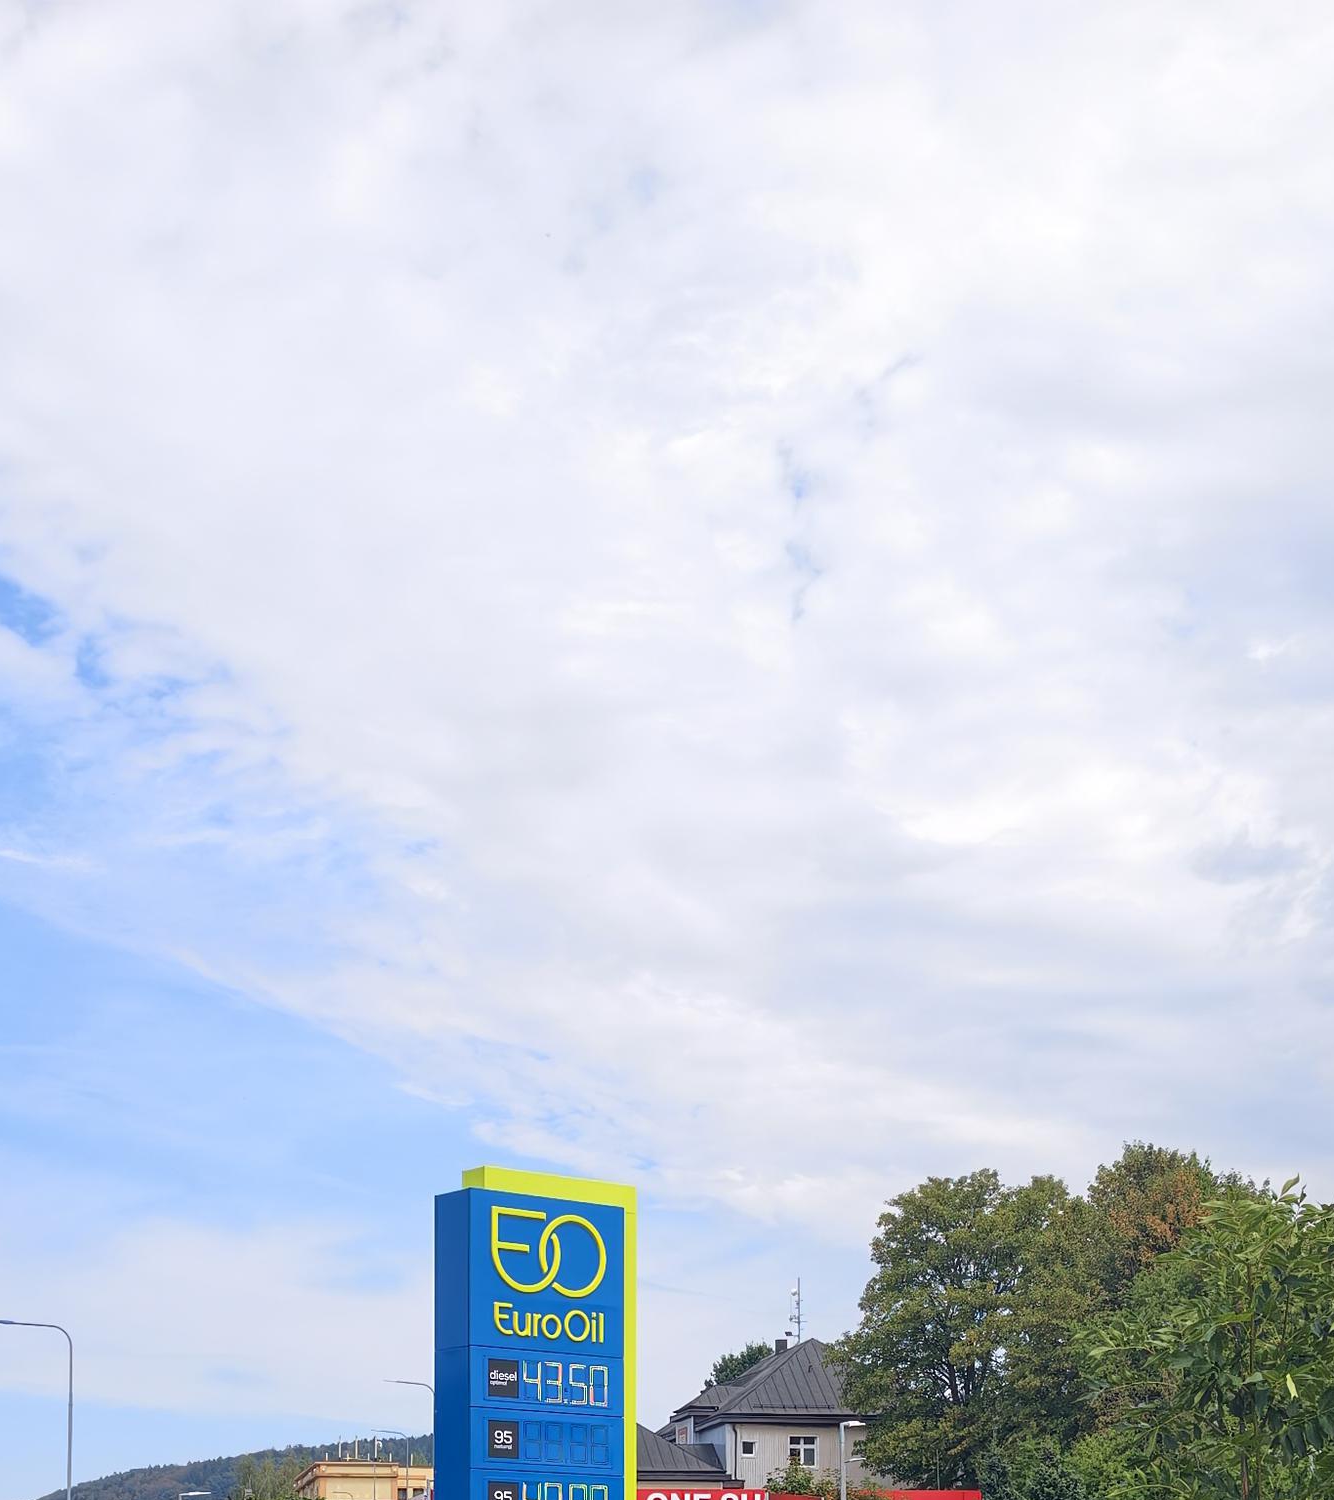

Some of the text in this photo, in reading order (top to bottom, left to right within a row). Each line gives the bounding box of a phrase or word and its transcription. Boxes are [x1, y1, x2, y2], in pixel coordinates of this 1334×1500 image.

[493, 1301, 604, 1344] EuroOil
[489, 1370, 517, 1382] diesel
[494, 1430, 513, 1444] 95
